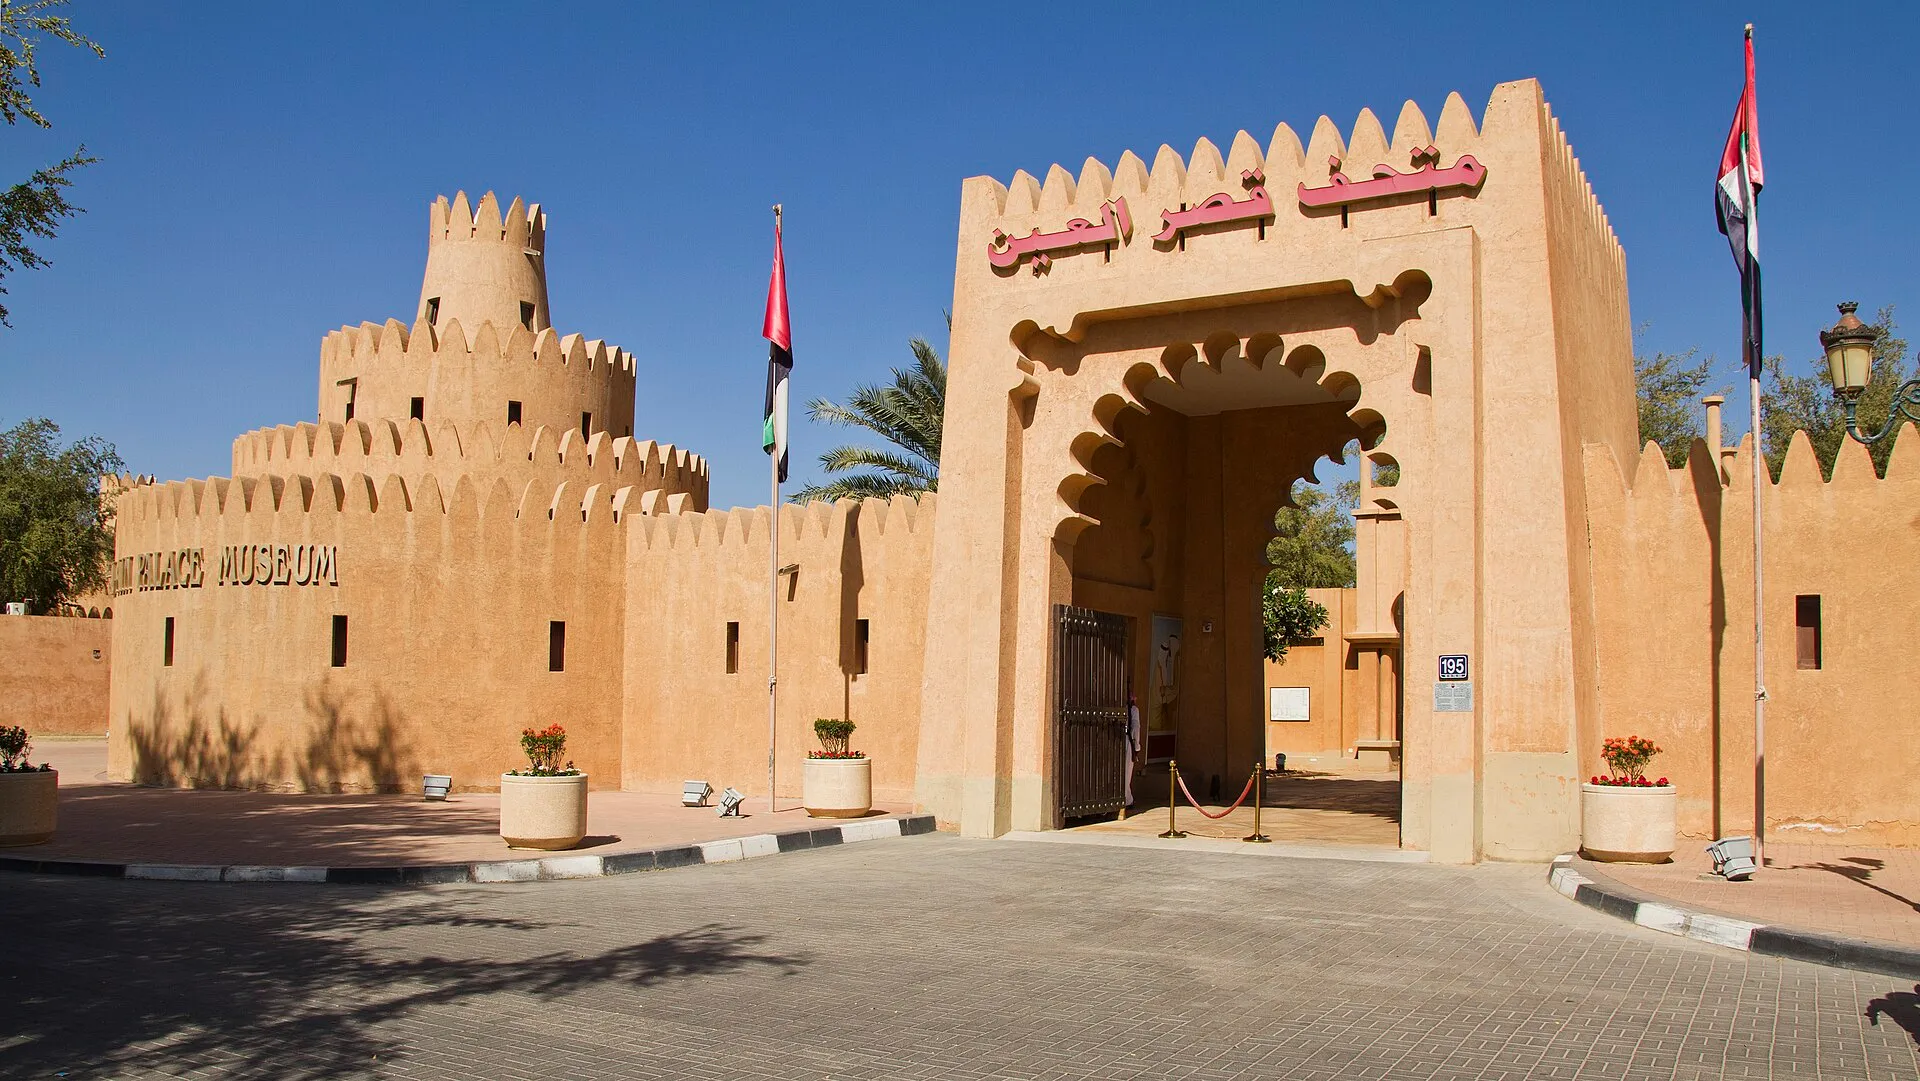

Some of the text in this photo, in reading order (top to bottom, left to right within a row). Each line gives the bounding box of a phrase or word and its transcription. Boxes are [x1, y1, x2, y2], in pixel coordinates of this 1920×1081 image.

[987, 145, 1487, 274] متحف قصر العين
[137, 548, 204, 592] PALACE
[218, 544, 339, 586] MUSEUM
[1441, 658, 1465, 674] 195
